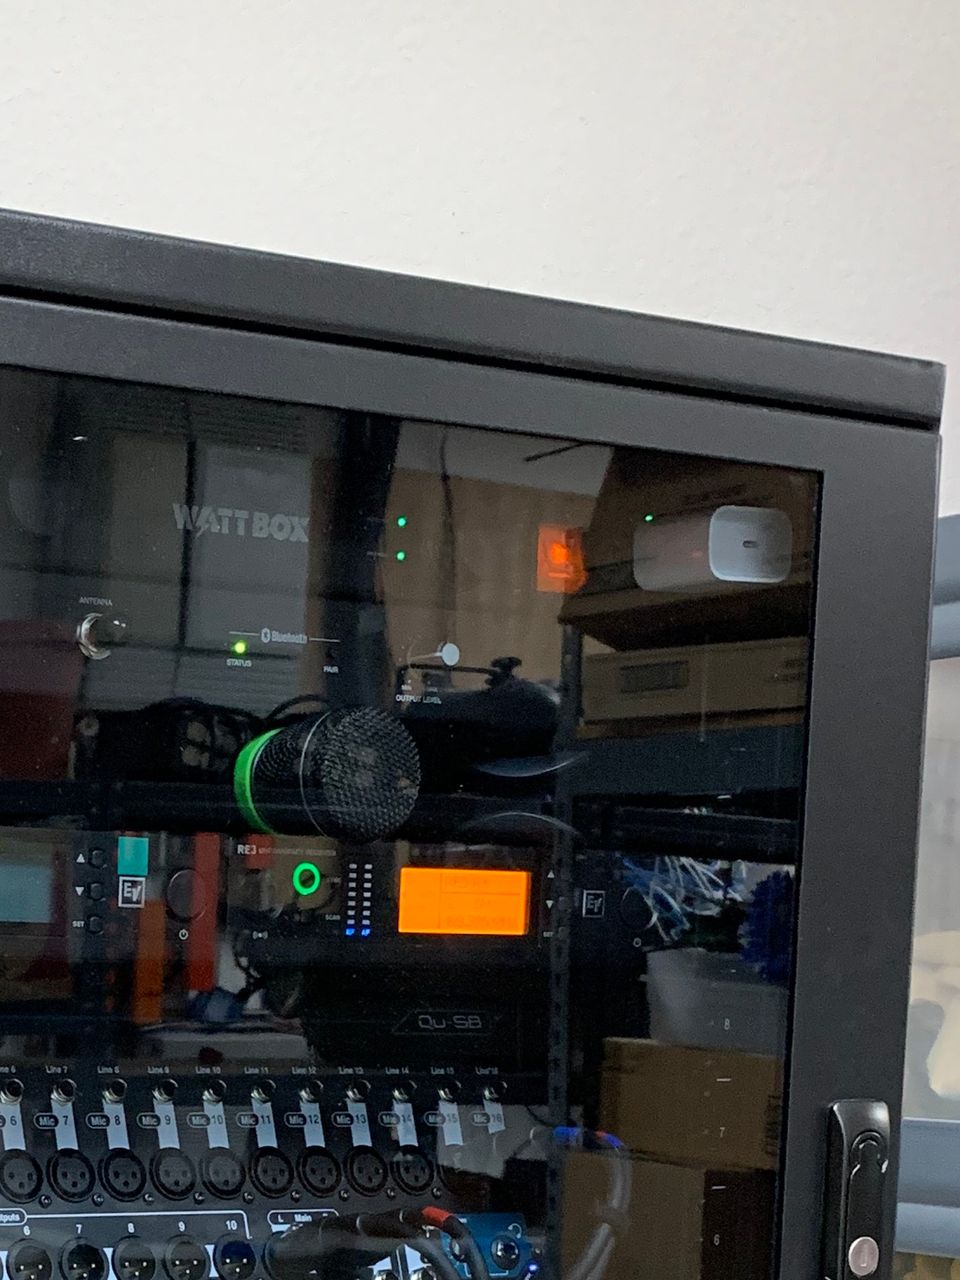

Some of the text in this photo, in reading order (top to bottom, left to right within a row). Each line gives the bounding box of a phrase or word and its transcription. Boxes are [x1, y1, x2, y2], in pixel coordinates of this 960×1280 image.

[226, 658, 252, 668] STATUS
[237, 844, 257, 855] RE3
[72, 920, 85, 928] SET
[45, 1065, 62, 1074] Line
[97, 1065, 113, 1074] Line
[195, 1066, 211, 1074] Line
[10, 1115, 17, 1126] 6
[39, 1115, 69, 1127] Mic 7
[90, 1114, 121, 1126] Mic 8
[141, 1115, 171, 1126] Mic 9
[719, 1126, 726, 1138] 7
[278, 1214, 312, 1223] L Main
[75, 1224, 82, 1234] 7
[127, 1223, 135, 1233] 8
[179, 1221, 186, 1232] 9
[226, 1220, 238, 1230] 10
[23, 1226, 31, 1236] 6
[713, 1233, 720, 1246] 6
